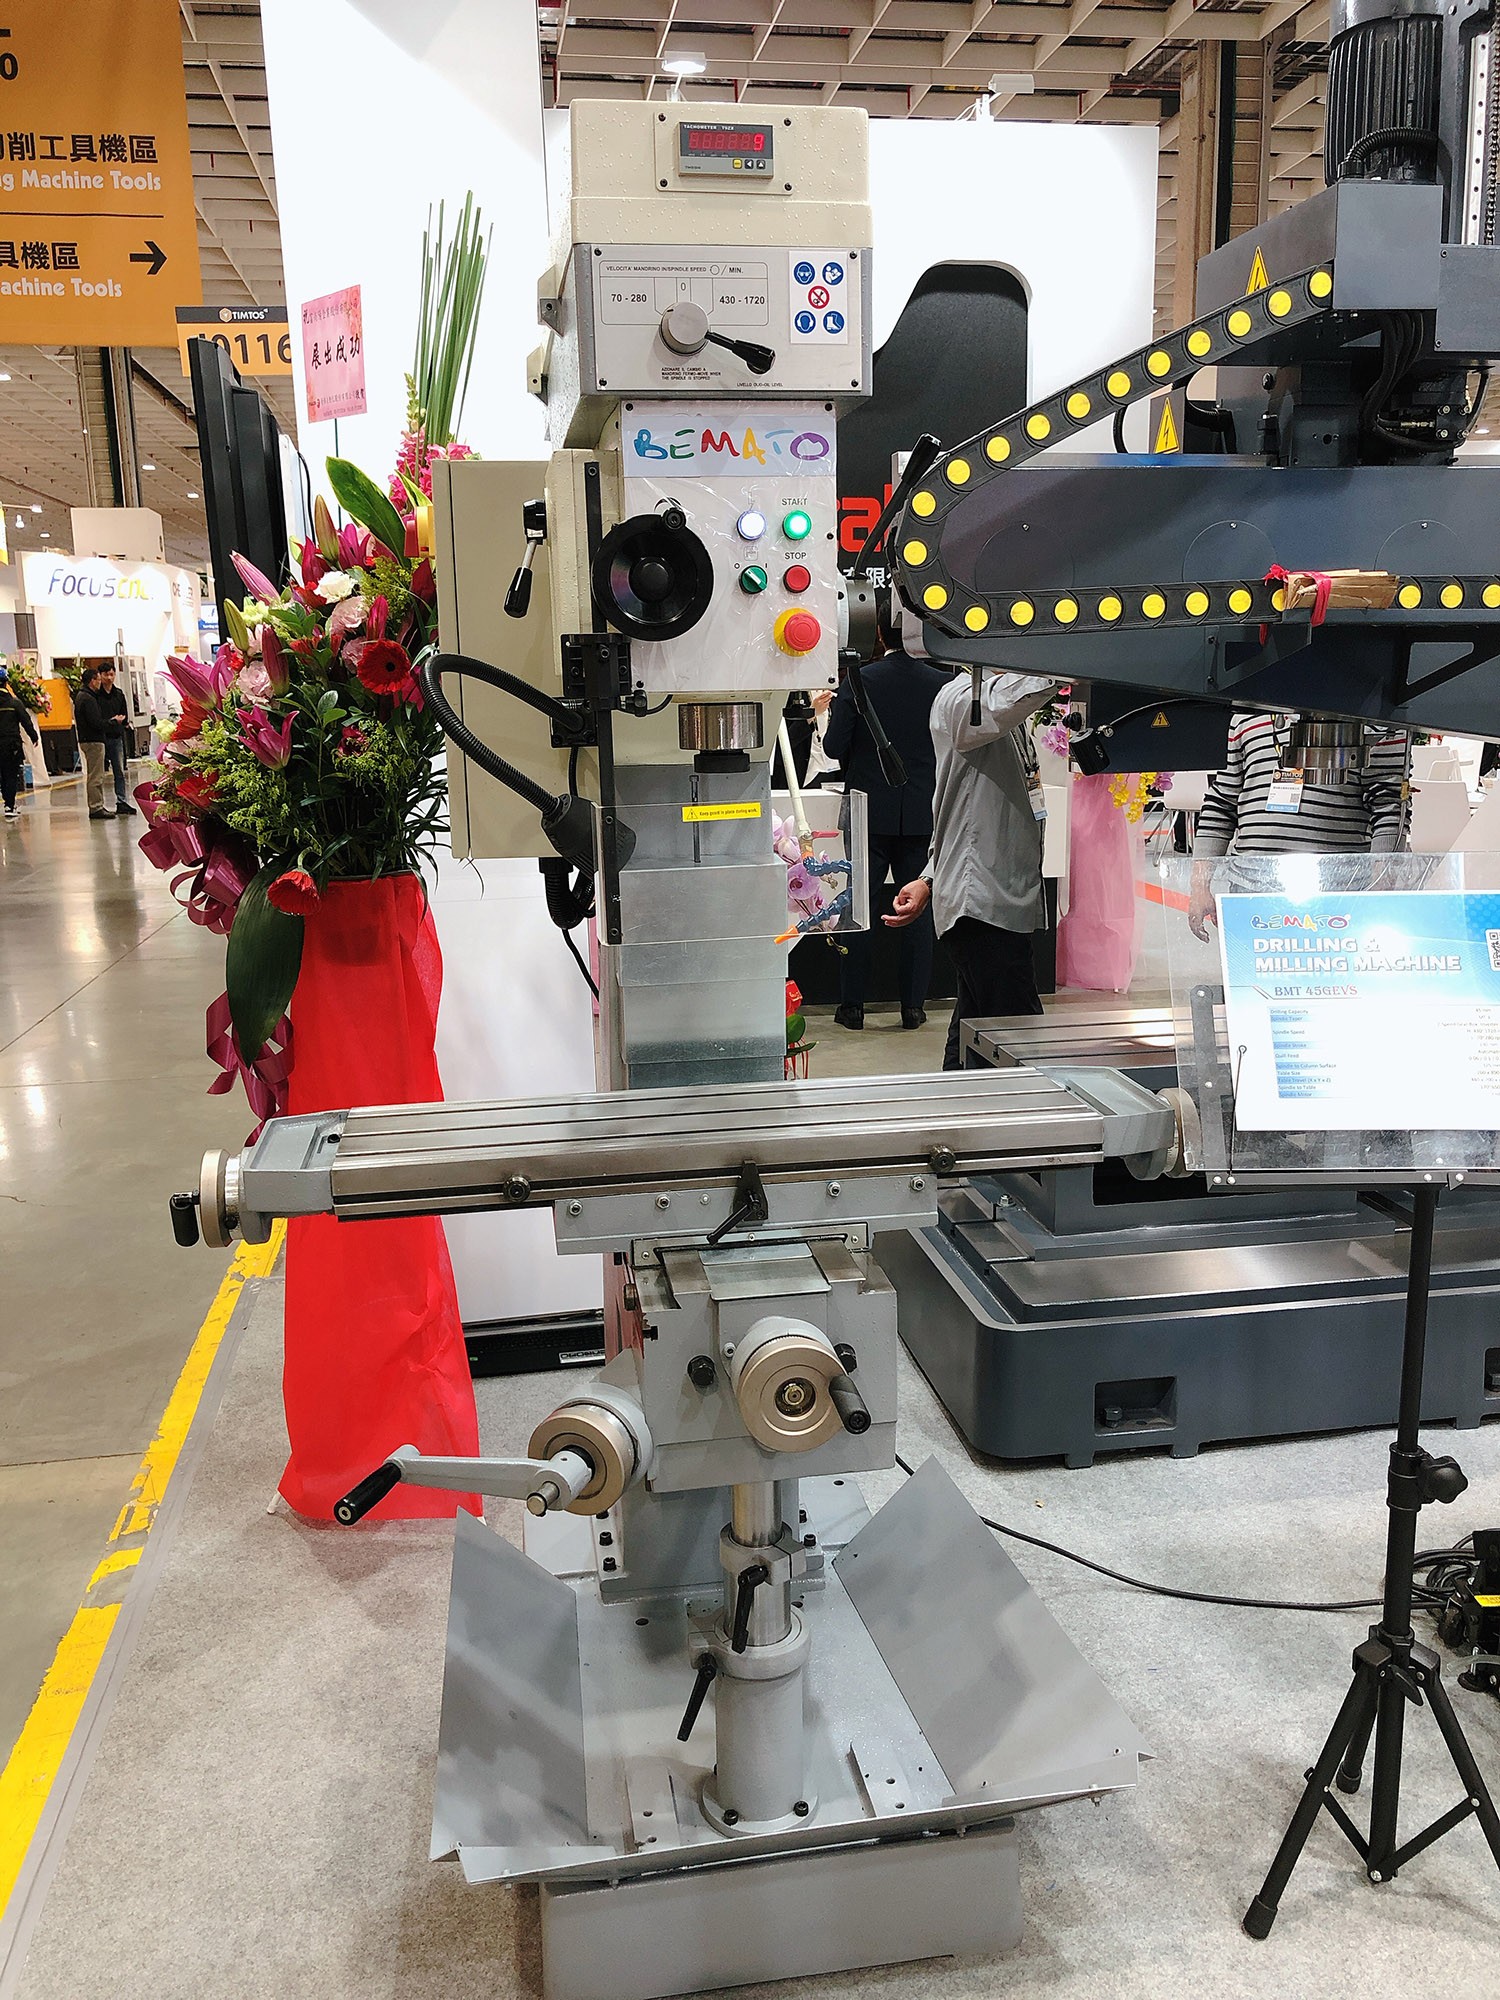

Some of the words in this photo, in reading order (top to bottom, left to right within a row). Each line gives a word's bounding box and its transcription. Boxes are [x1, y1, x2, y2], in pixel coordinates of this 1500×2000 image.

[753, 132, 764, 150] 9
[22, 169, 104, 189] Machine
[110, 171, 161, 190] Tools
[71, 278, 122, 297] Tools
[611, 294, 622, 302] 70
[630, 294, 647, 302] 280
[719, 296, 735, 304] 430
[744, 296, 765, 305] 1720
[232, 308, 265, 320] TIMTOS
[633, 427, 829, 465] BEMATO
[781, 498, 807, 506] START
[784, 552, 806, 560] STOP
[1251, 914, 1348, 931] BEMATO
[1253, 938, 1358, 953] DRILLING
[1255, 957, 1348, 972] MILLING
[1353, 956, 1462, 972] MACHINE
[1274, 986, 1302, 996] BMT
[1305, 985, 1358, 996] 45GEVS
